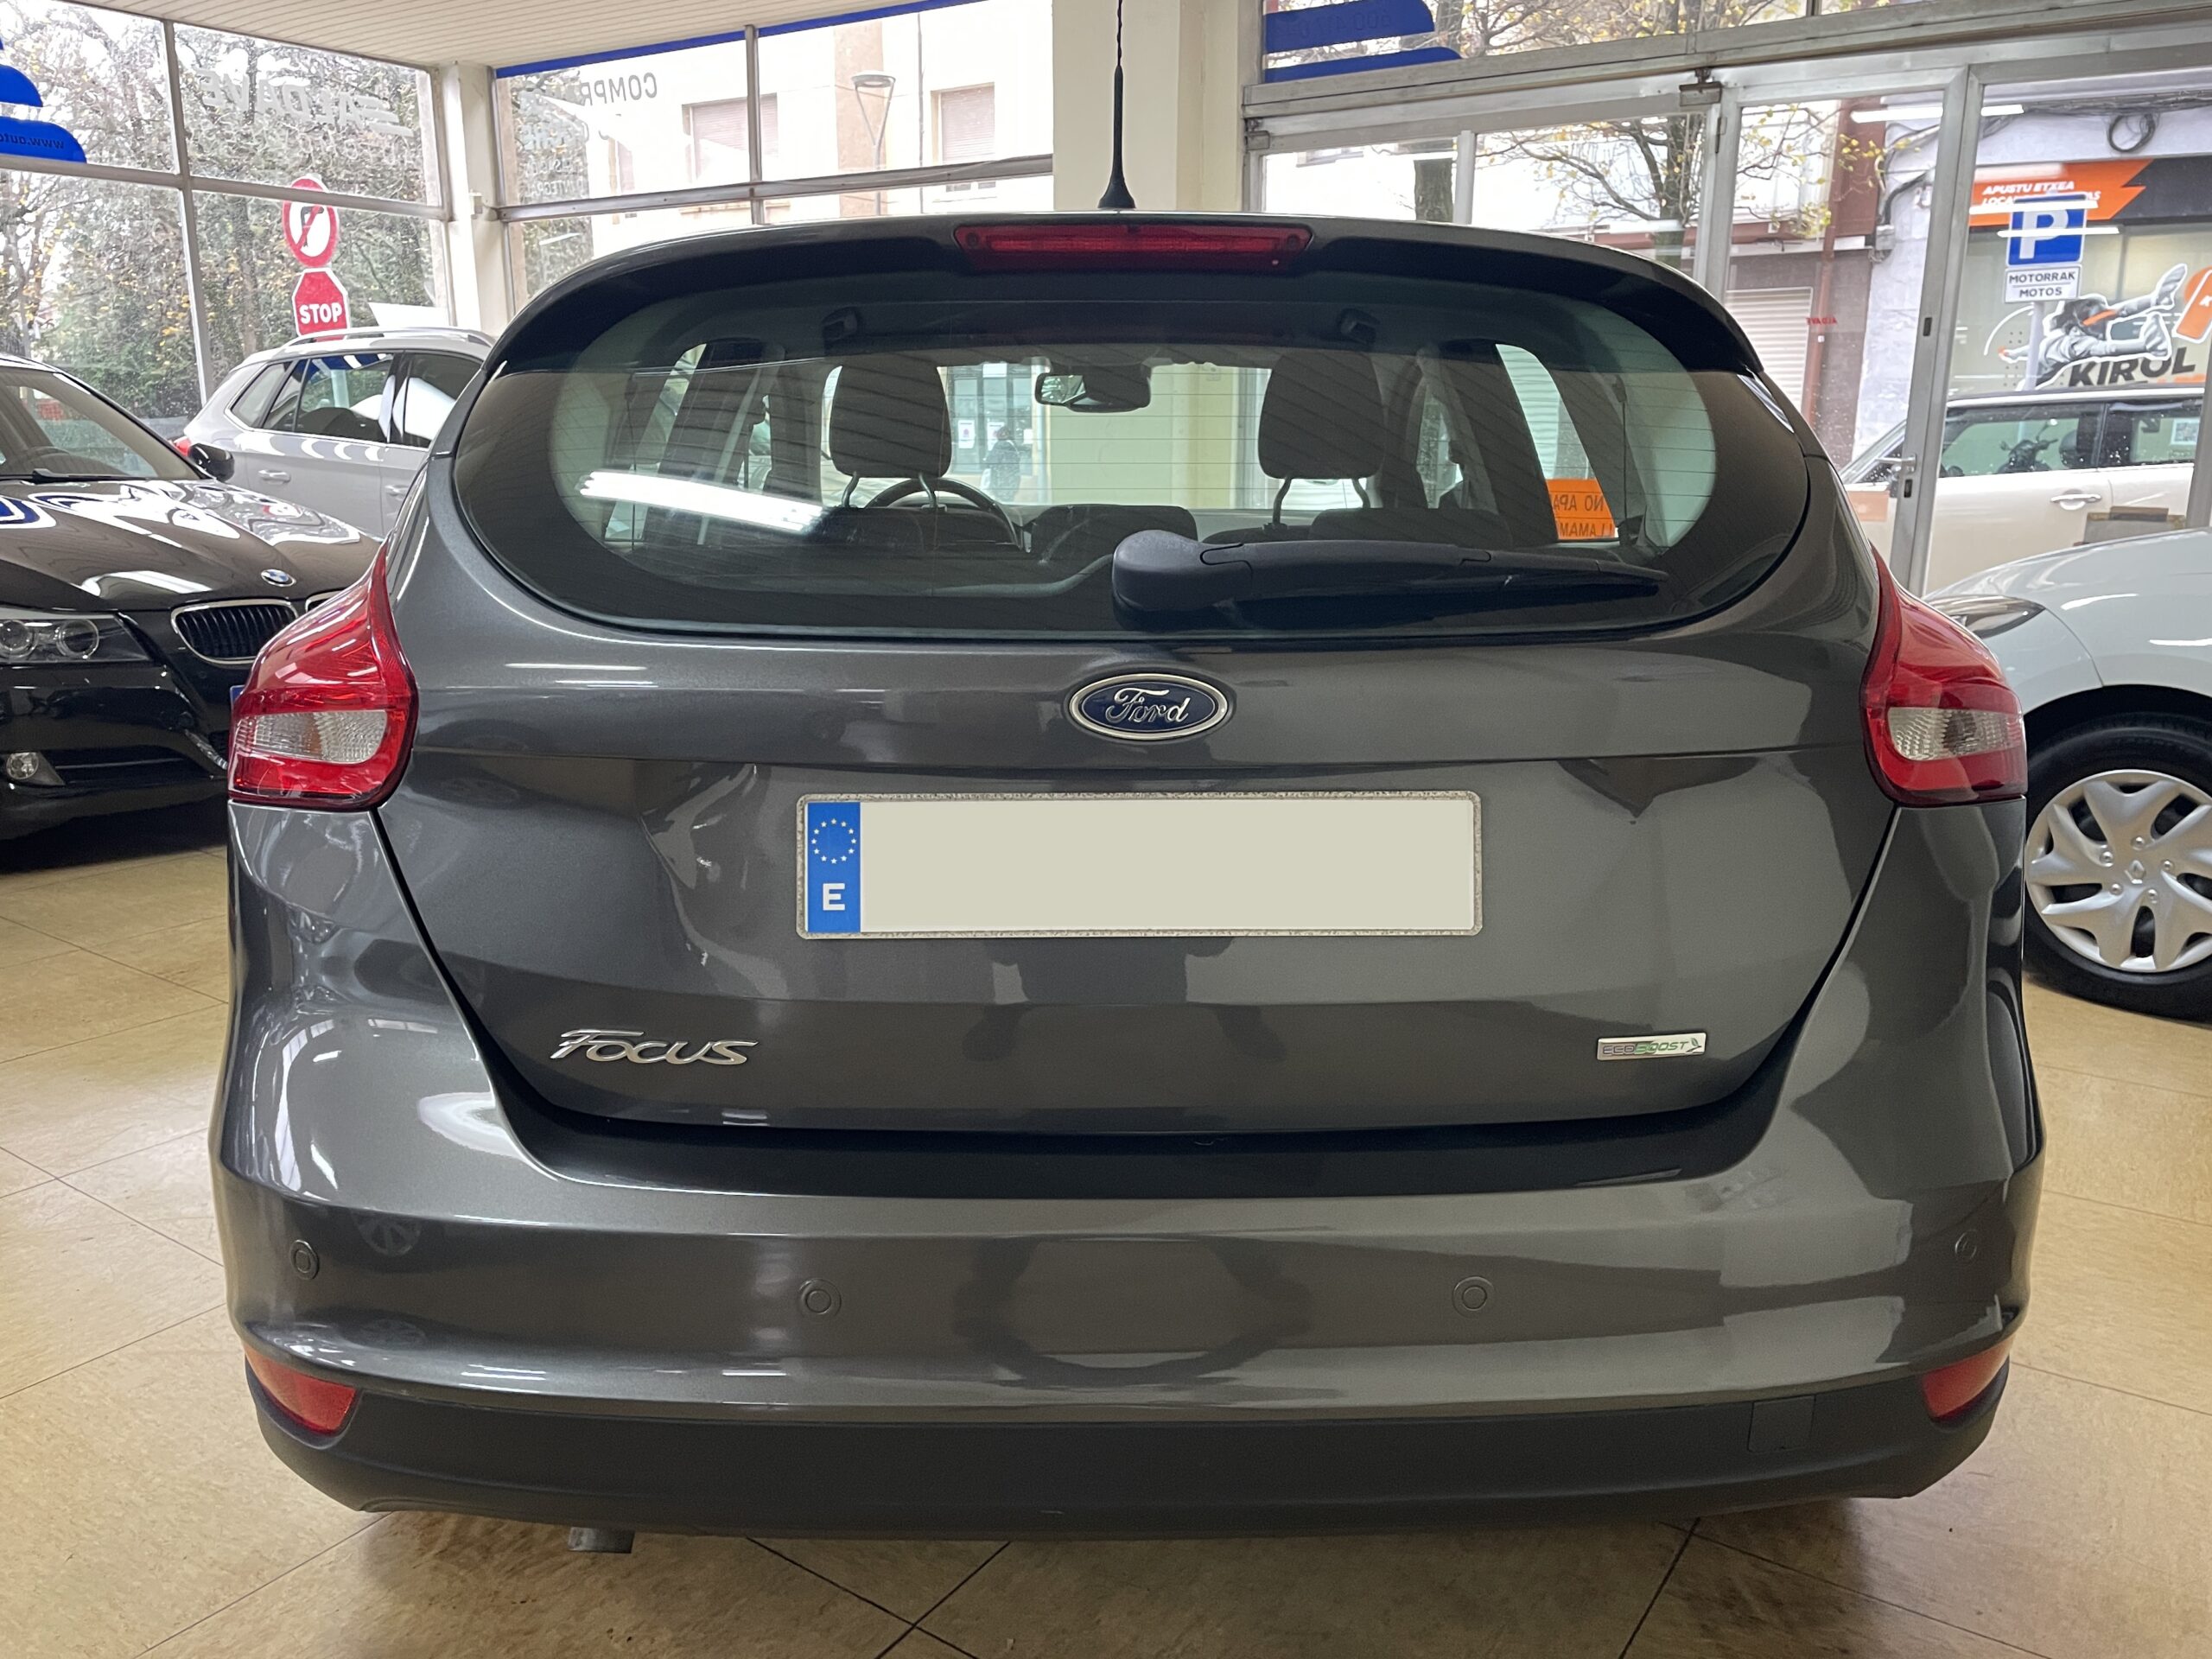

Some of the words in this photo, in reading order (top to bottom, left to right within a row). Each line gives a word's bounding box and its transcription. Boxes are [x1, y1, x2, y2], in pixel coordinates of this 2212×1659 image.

[1982, 183, 2033, 195] APUSTU
[2033, 181, 2075, 192] ETXEA
[2018, 207, 2069, 259] P
[2009, 271, 2075, 283] MOTORRAK
[2018, 287, 2063, 298] MOTOS
[299, 302, 343, 325] STOP
[2069, 346, 2196, 388] KIROL
[1104, 687, 1191, 724] Ford
[823, 882, 846, 912] E
